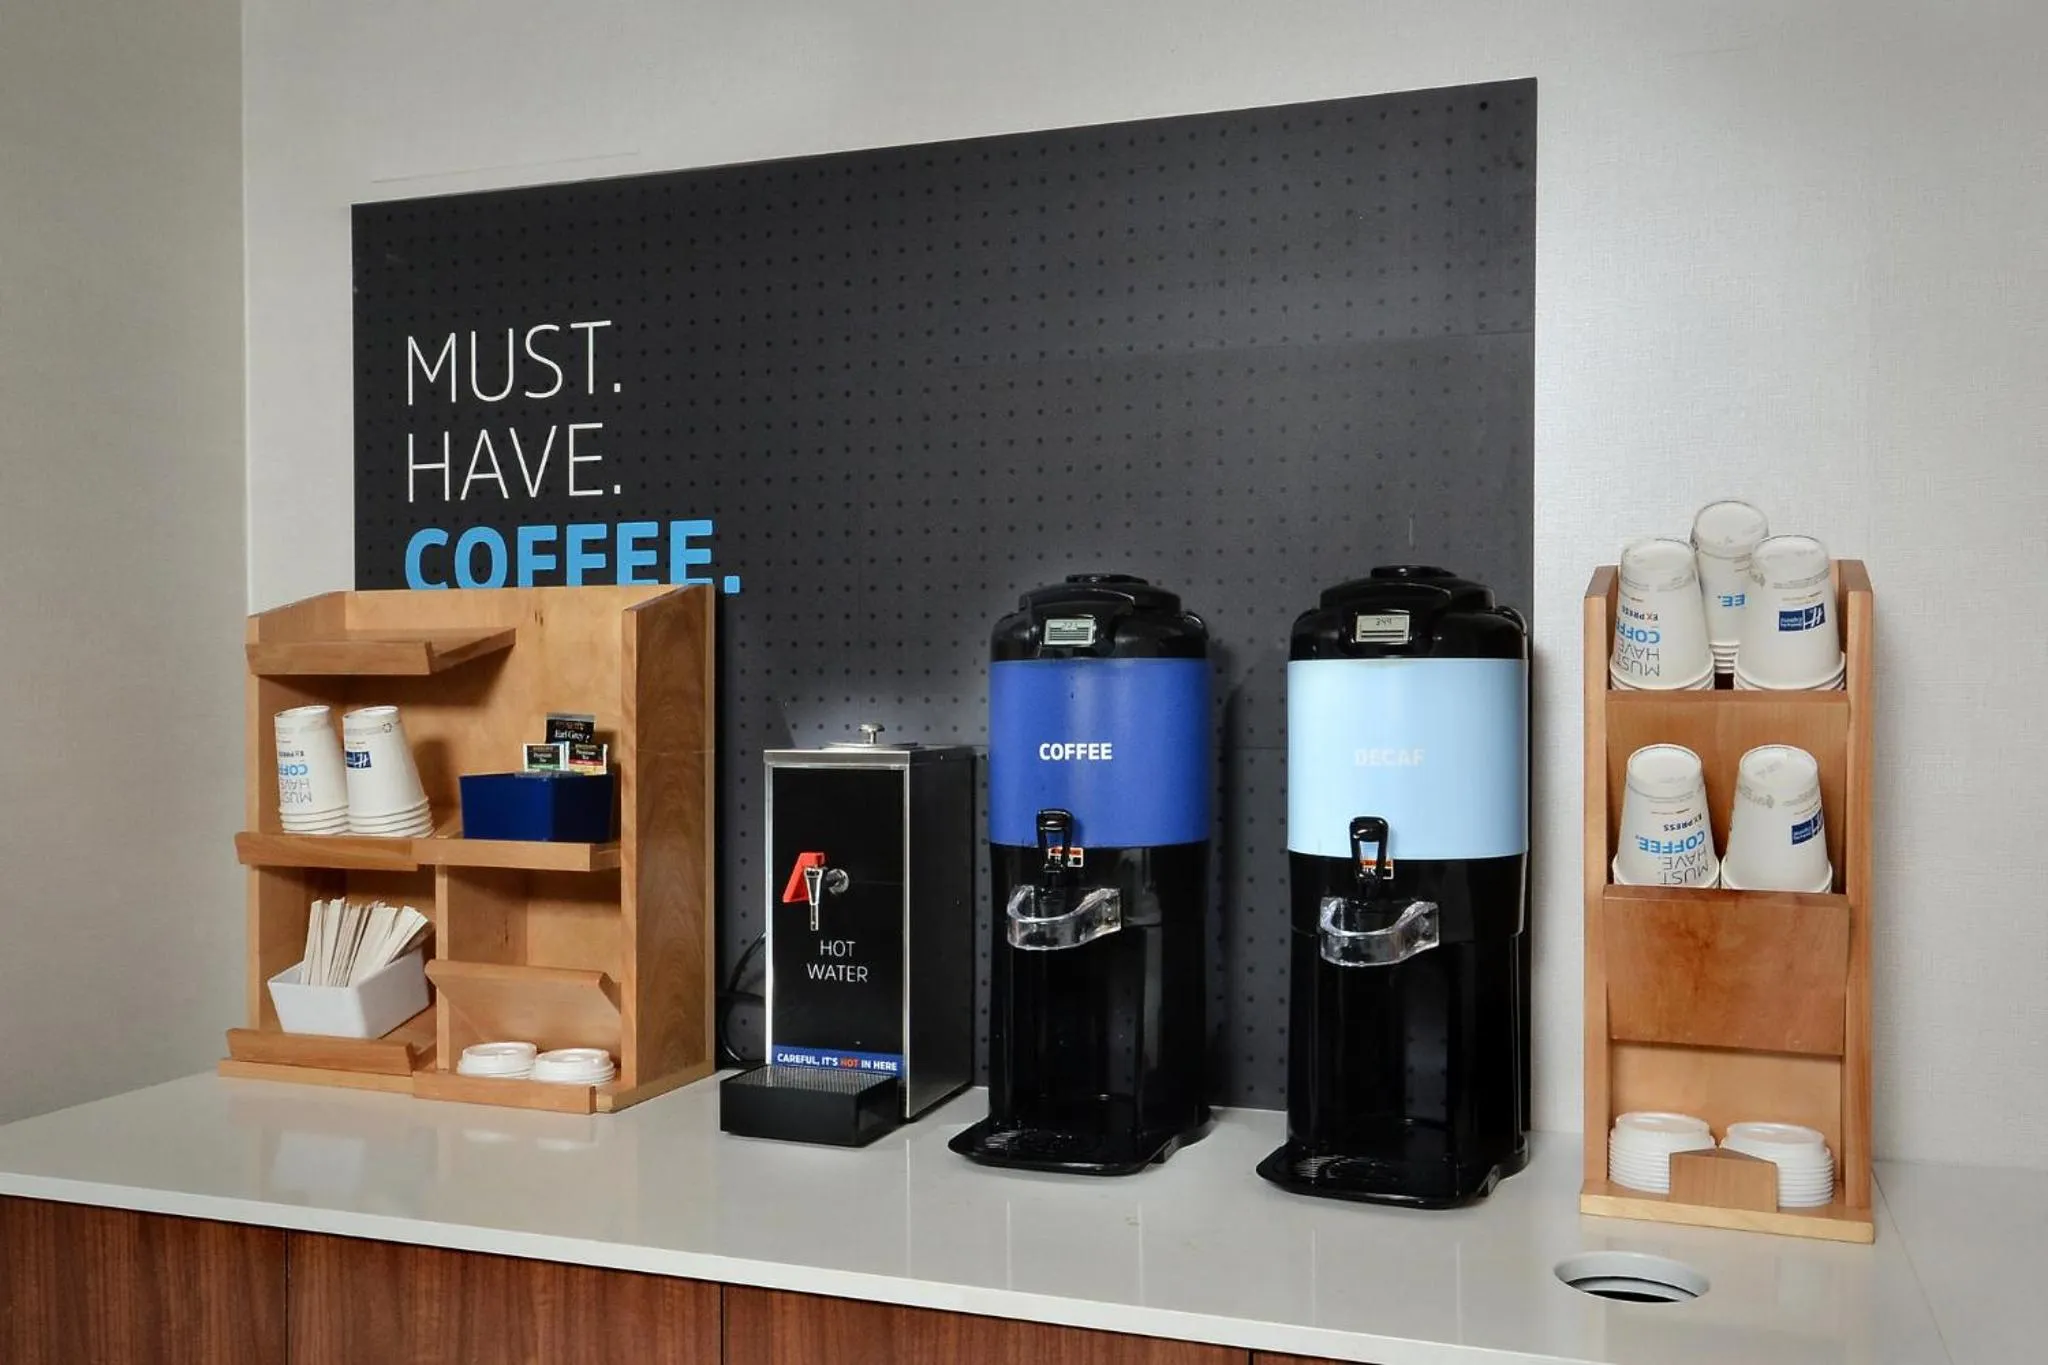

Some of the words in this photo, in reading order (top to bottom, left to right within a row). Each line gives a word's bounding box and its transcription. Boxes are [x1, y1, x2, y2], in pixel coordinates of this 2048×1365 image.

[408, 320, 621, 406] MUST.
[408, 422, 621, 503] HAVE.
[405, 519, 741, 595] COFFEE.
[1038, 742, 1113, 761] COFFEE
[1354, 747, 1425, 768] DECAF
[819, 939, 856, 957] HOT
[806, 963, 868, 983] WATER
[777, 1053, 820, 1066] CAREFUL,
[821, 1057, 838, 1067] IT'S
[841, 1058, 859, 1068] HOT
[861, 1060, 871, 1069] IN
[873, 1061, 898, 1071] HERE
